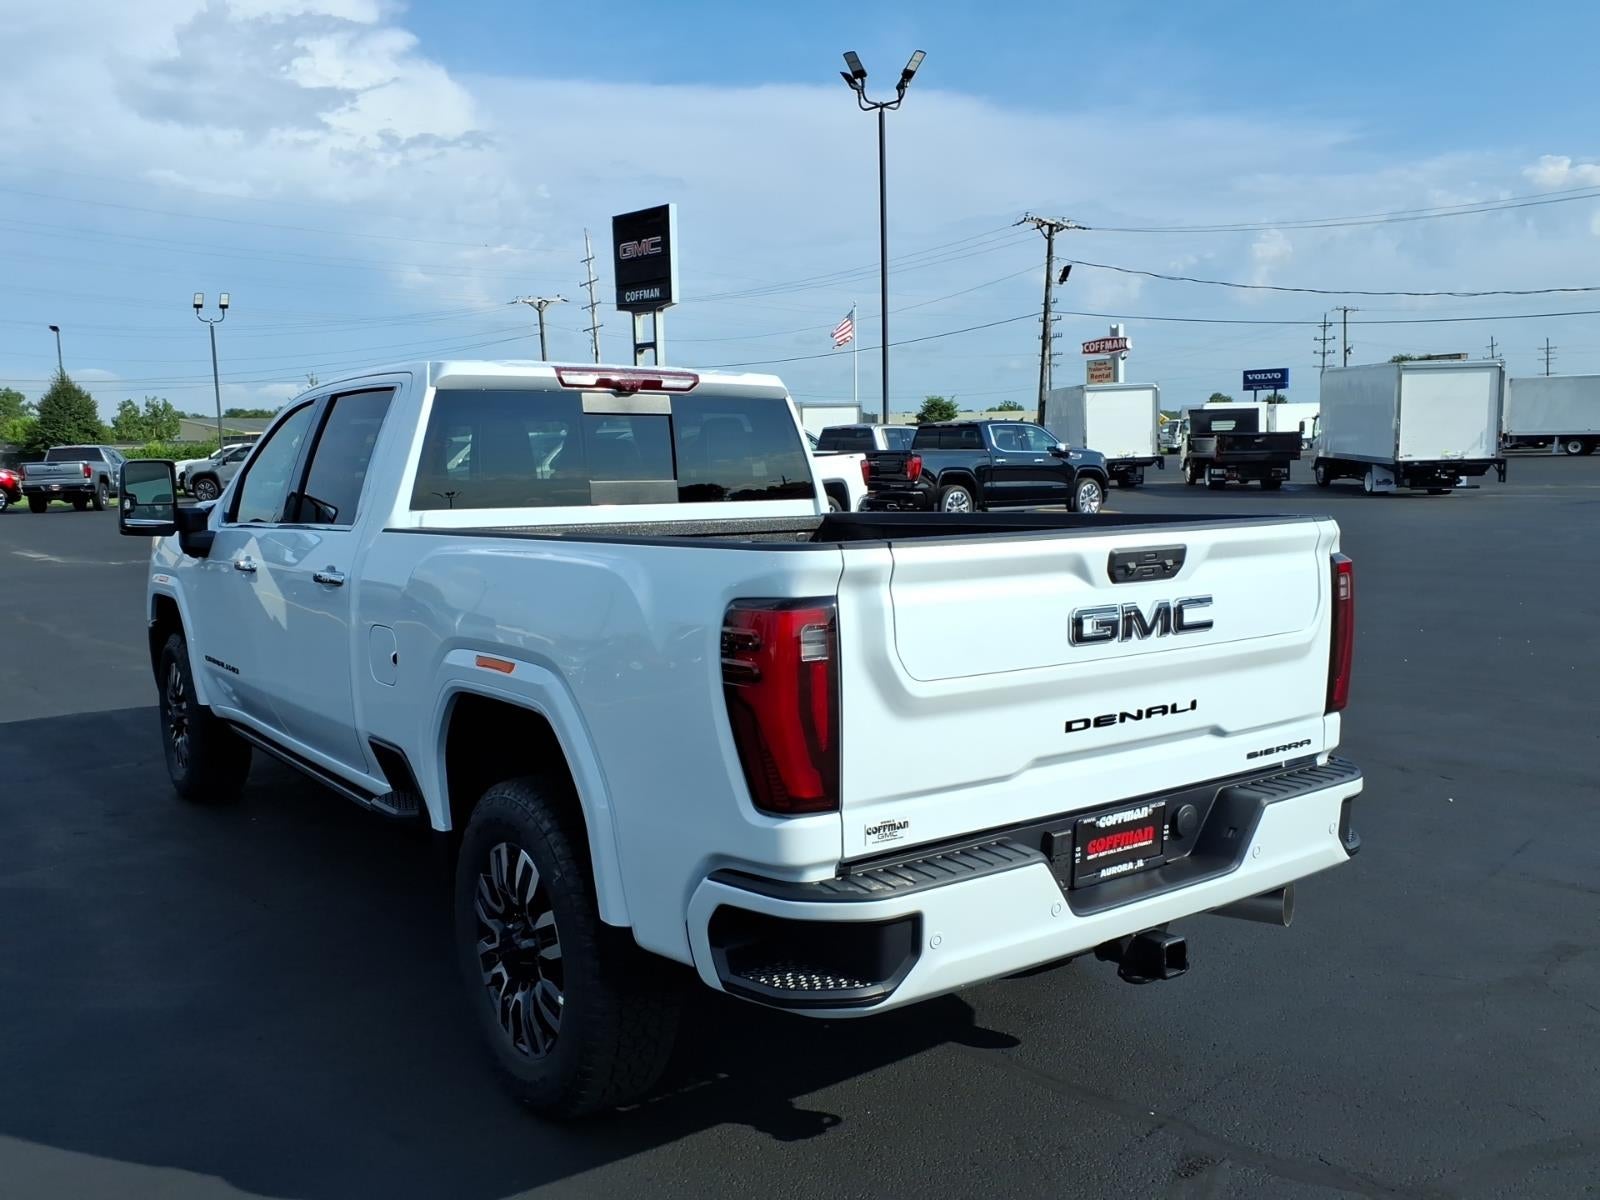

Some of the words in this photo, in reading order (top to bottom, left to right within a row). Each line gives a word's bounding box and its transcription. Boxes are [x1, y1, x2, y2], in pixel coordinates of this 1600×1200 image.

[619, 236, 662, 260] GMC
[625, 288, 660, 302] COFFMAN
[1083, 339, 1126, 353] COFFMAN
[1090, 371, 1111, 380] Rental
[1247, 372, 1281, 380] VOLVO
[1068, 594, 1214, 647] GMC
[1065, 699, 1197, 733] DENALI
[1246, 738, 1312, 759] SIERRA
[1099, 806, 1149, 828] COFFMAN
[878, 830, 898, 840] GMC
[1087, 826, 1155, 854] COFFMAN
[1100, 862, 1134, 877] AURORA
